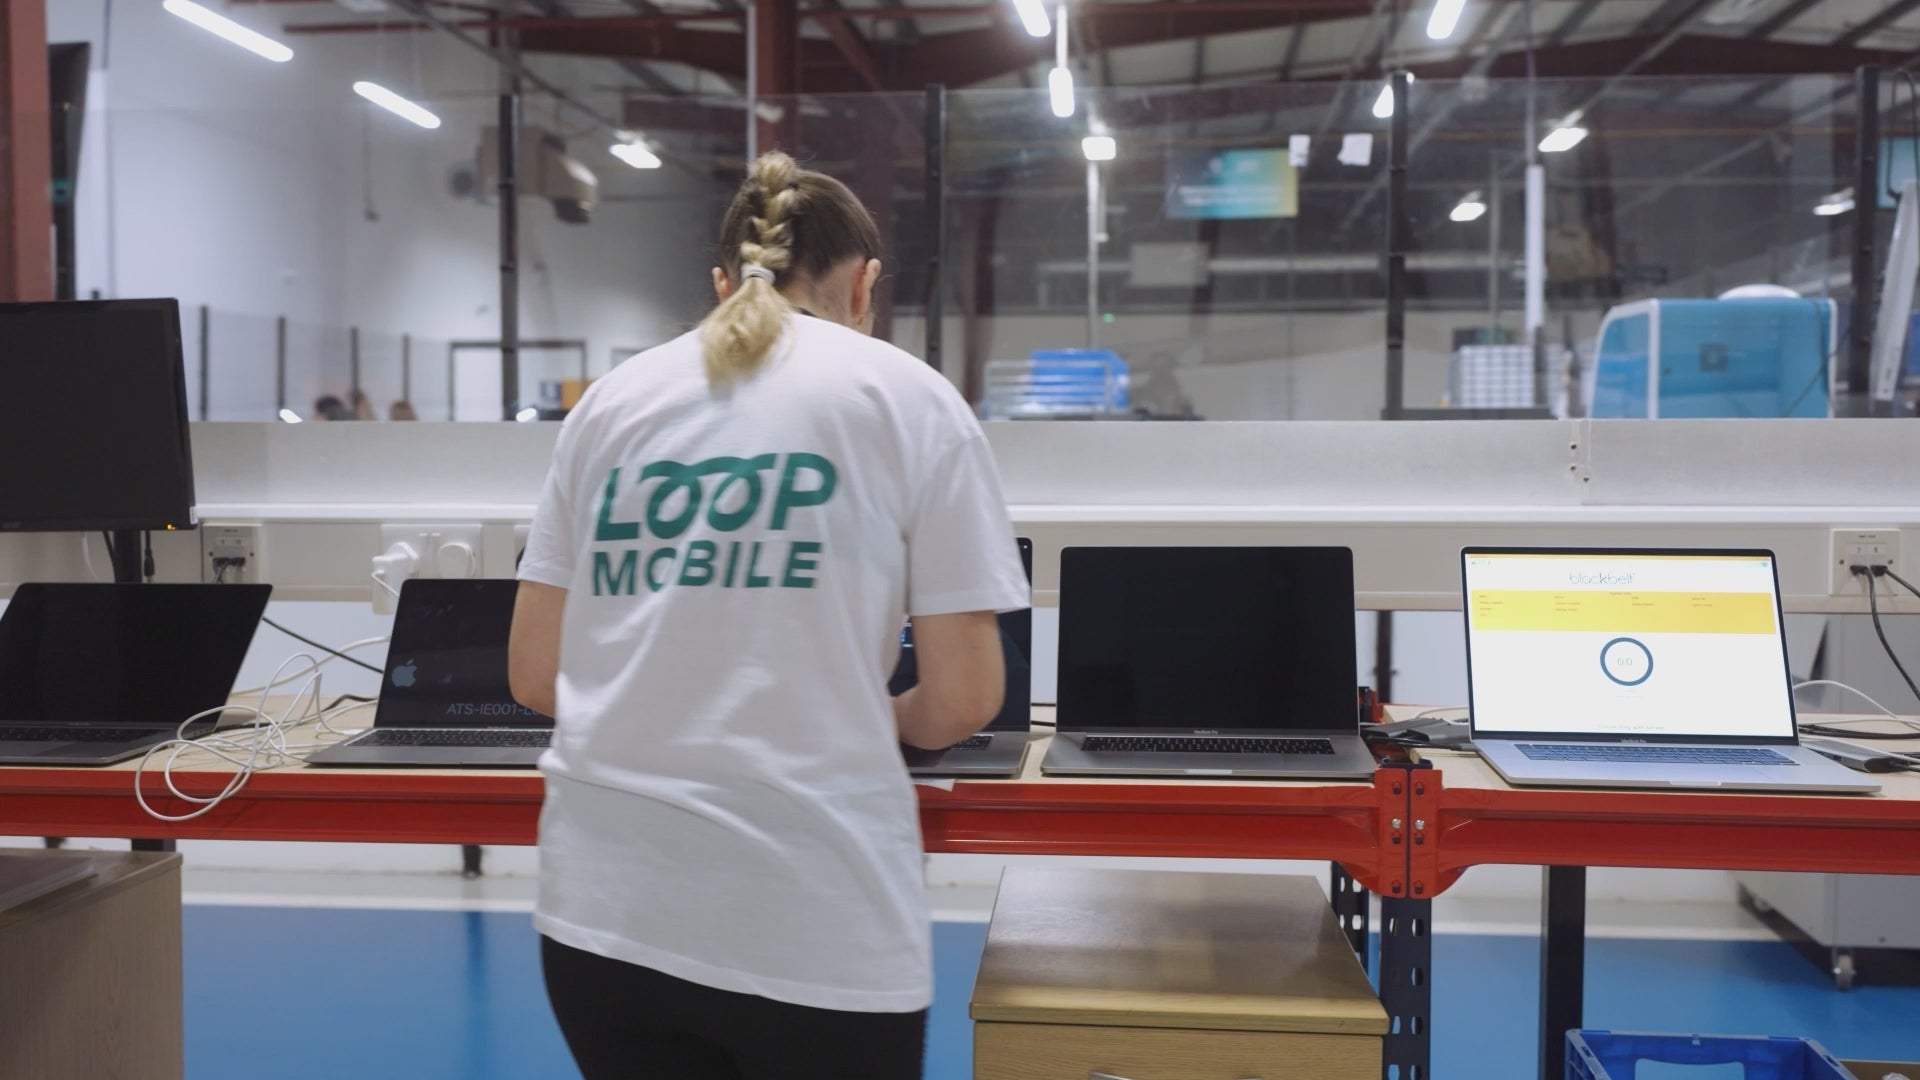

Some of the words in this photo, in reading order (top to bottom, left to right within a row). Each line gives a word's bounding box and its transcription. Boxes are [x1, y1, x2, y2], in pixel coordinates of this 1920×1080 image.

[594, 452, 837, 541] LOOP
[592, 540, 823, 597] MOBILE
[1569, 572, 1634, 585] blackbelt
